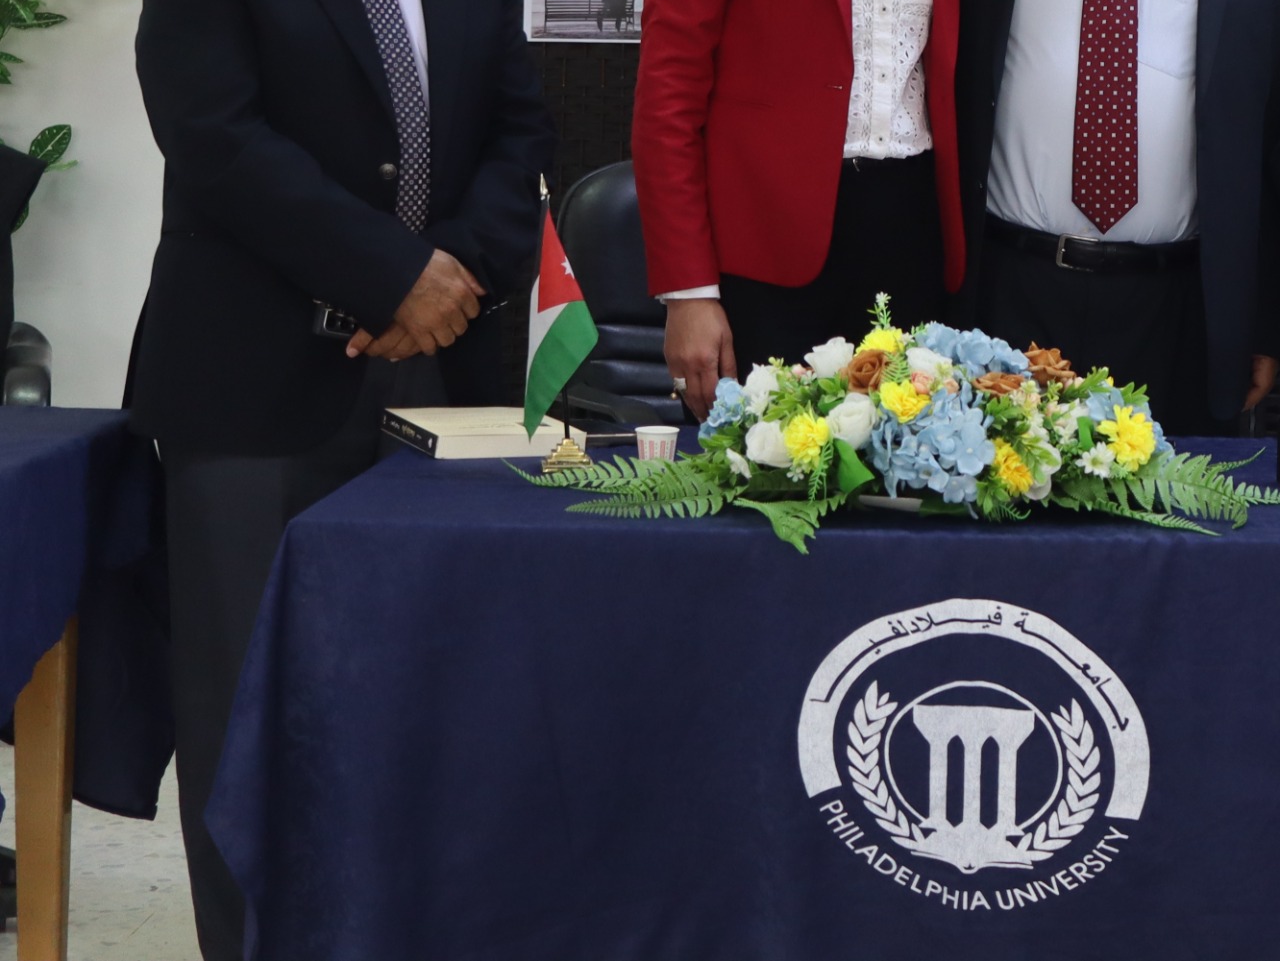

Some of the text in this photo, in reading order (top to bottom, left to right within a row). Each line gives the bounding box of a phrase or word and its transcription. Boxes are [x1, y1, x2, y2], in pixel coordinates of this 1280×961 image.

[1013, 611, 1130, 732] جامعة
[819, 798, 1130, 911] PHILADELPHIA UNIVERSITY
